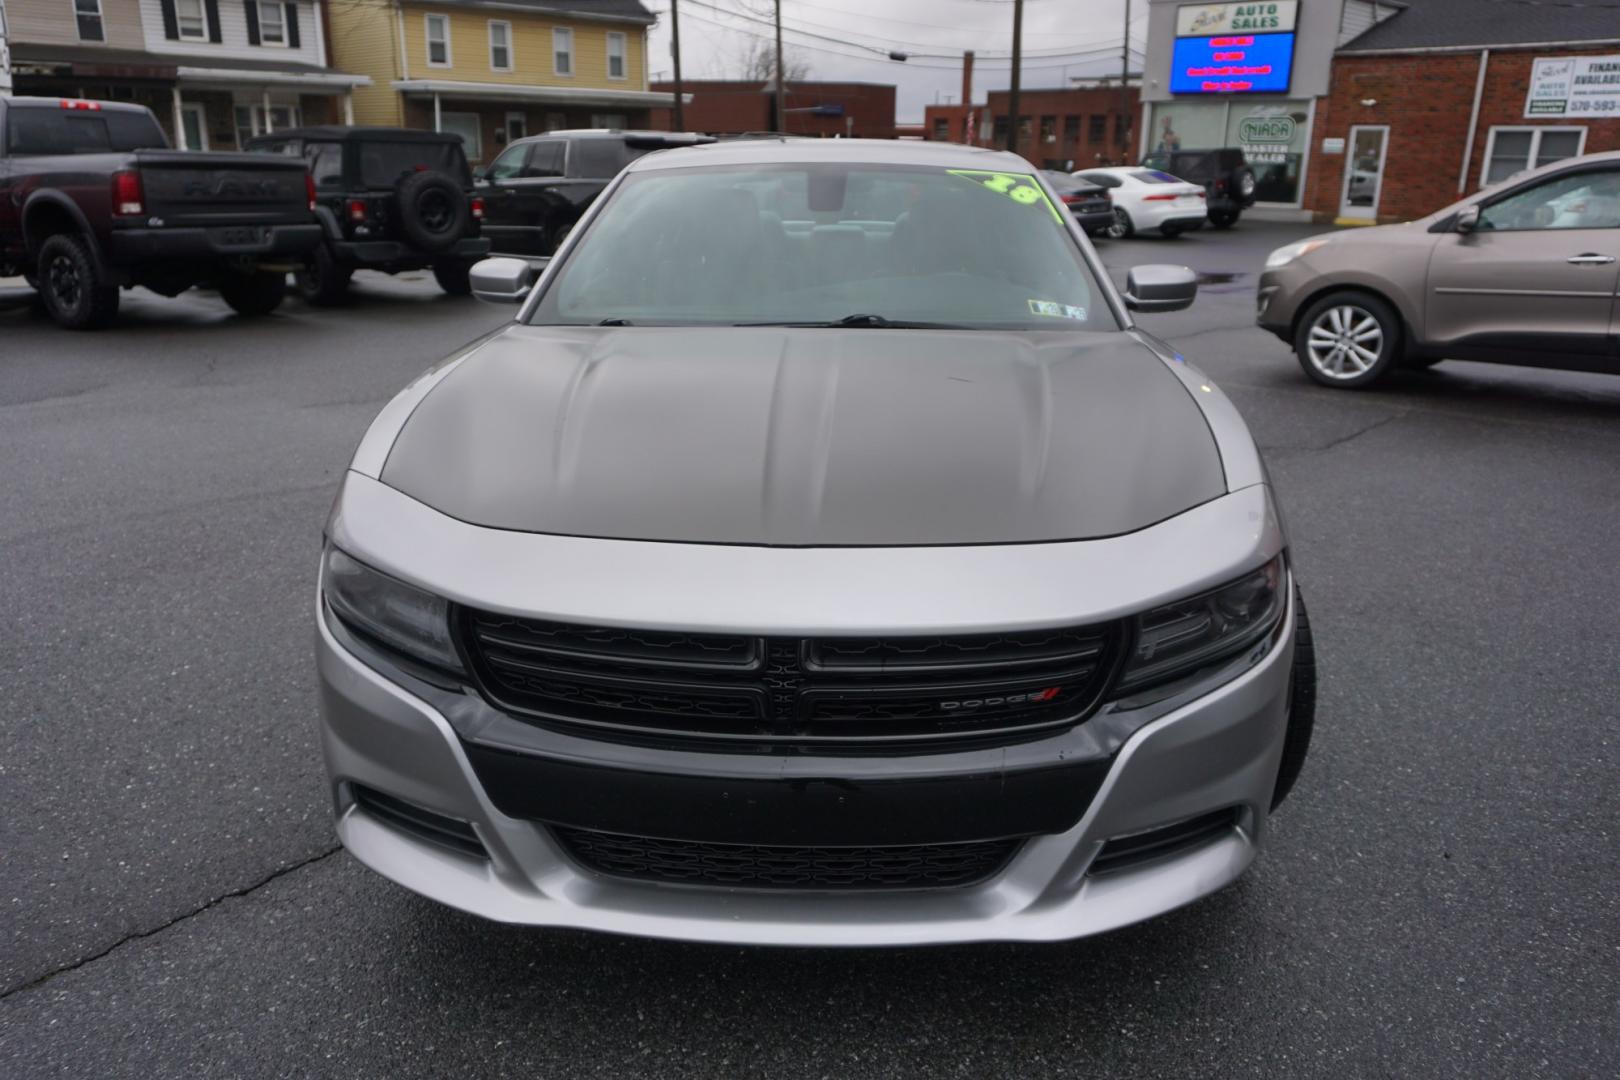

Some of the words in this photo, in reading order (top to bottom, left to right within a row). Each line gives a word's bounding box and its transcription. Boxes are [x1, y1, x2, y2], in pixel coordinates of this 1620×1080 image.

[1235, 4, 1277, 16] AUTO
[1231, 16, 1279, 29] SALES
[1588, 62, 1620, 73] FINAN
[1244, 123, 1289, 137] NIADA
[184, 177, 277, 196] RAM
[941, 692, 1043, 709] DODGE
